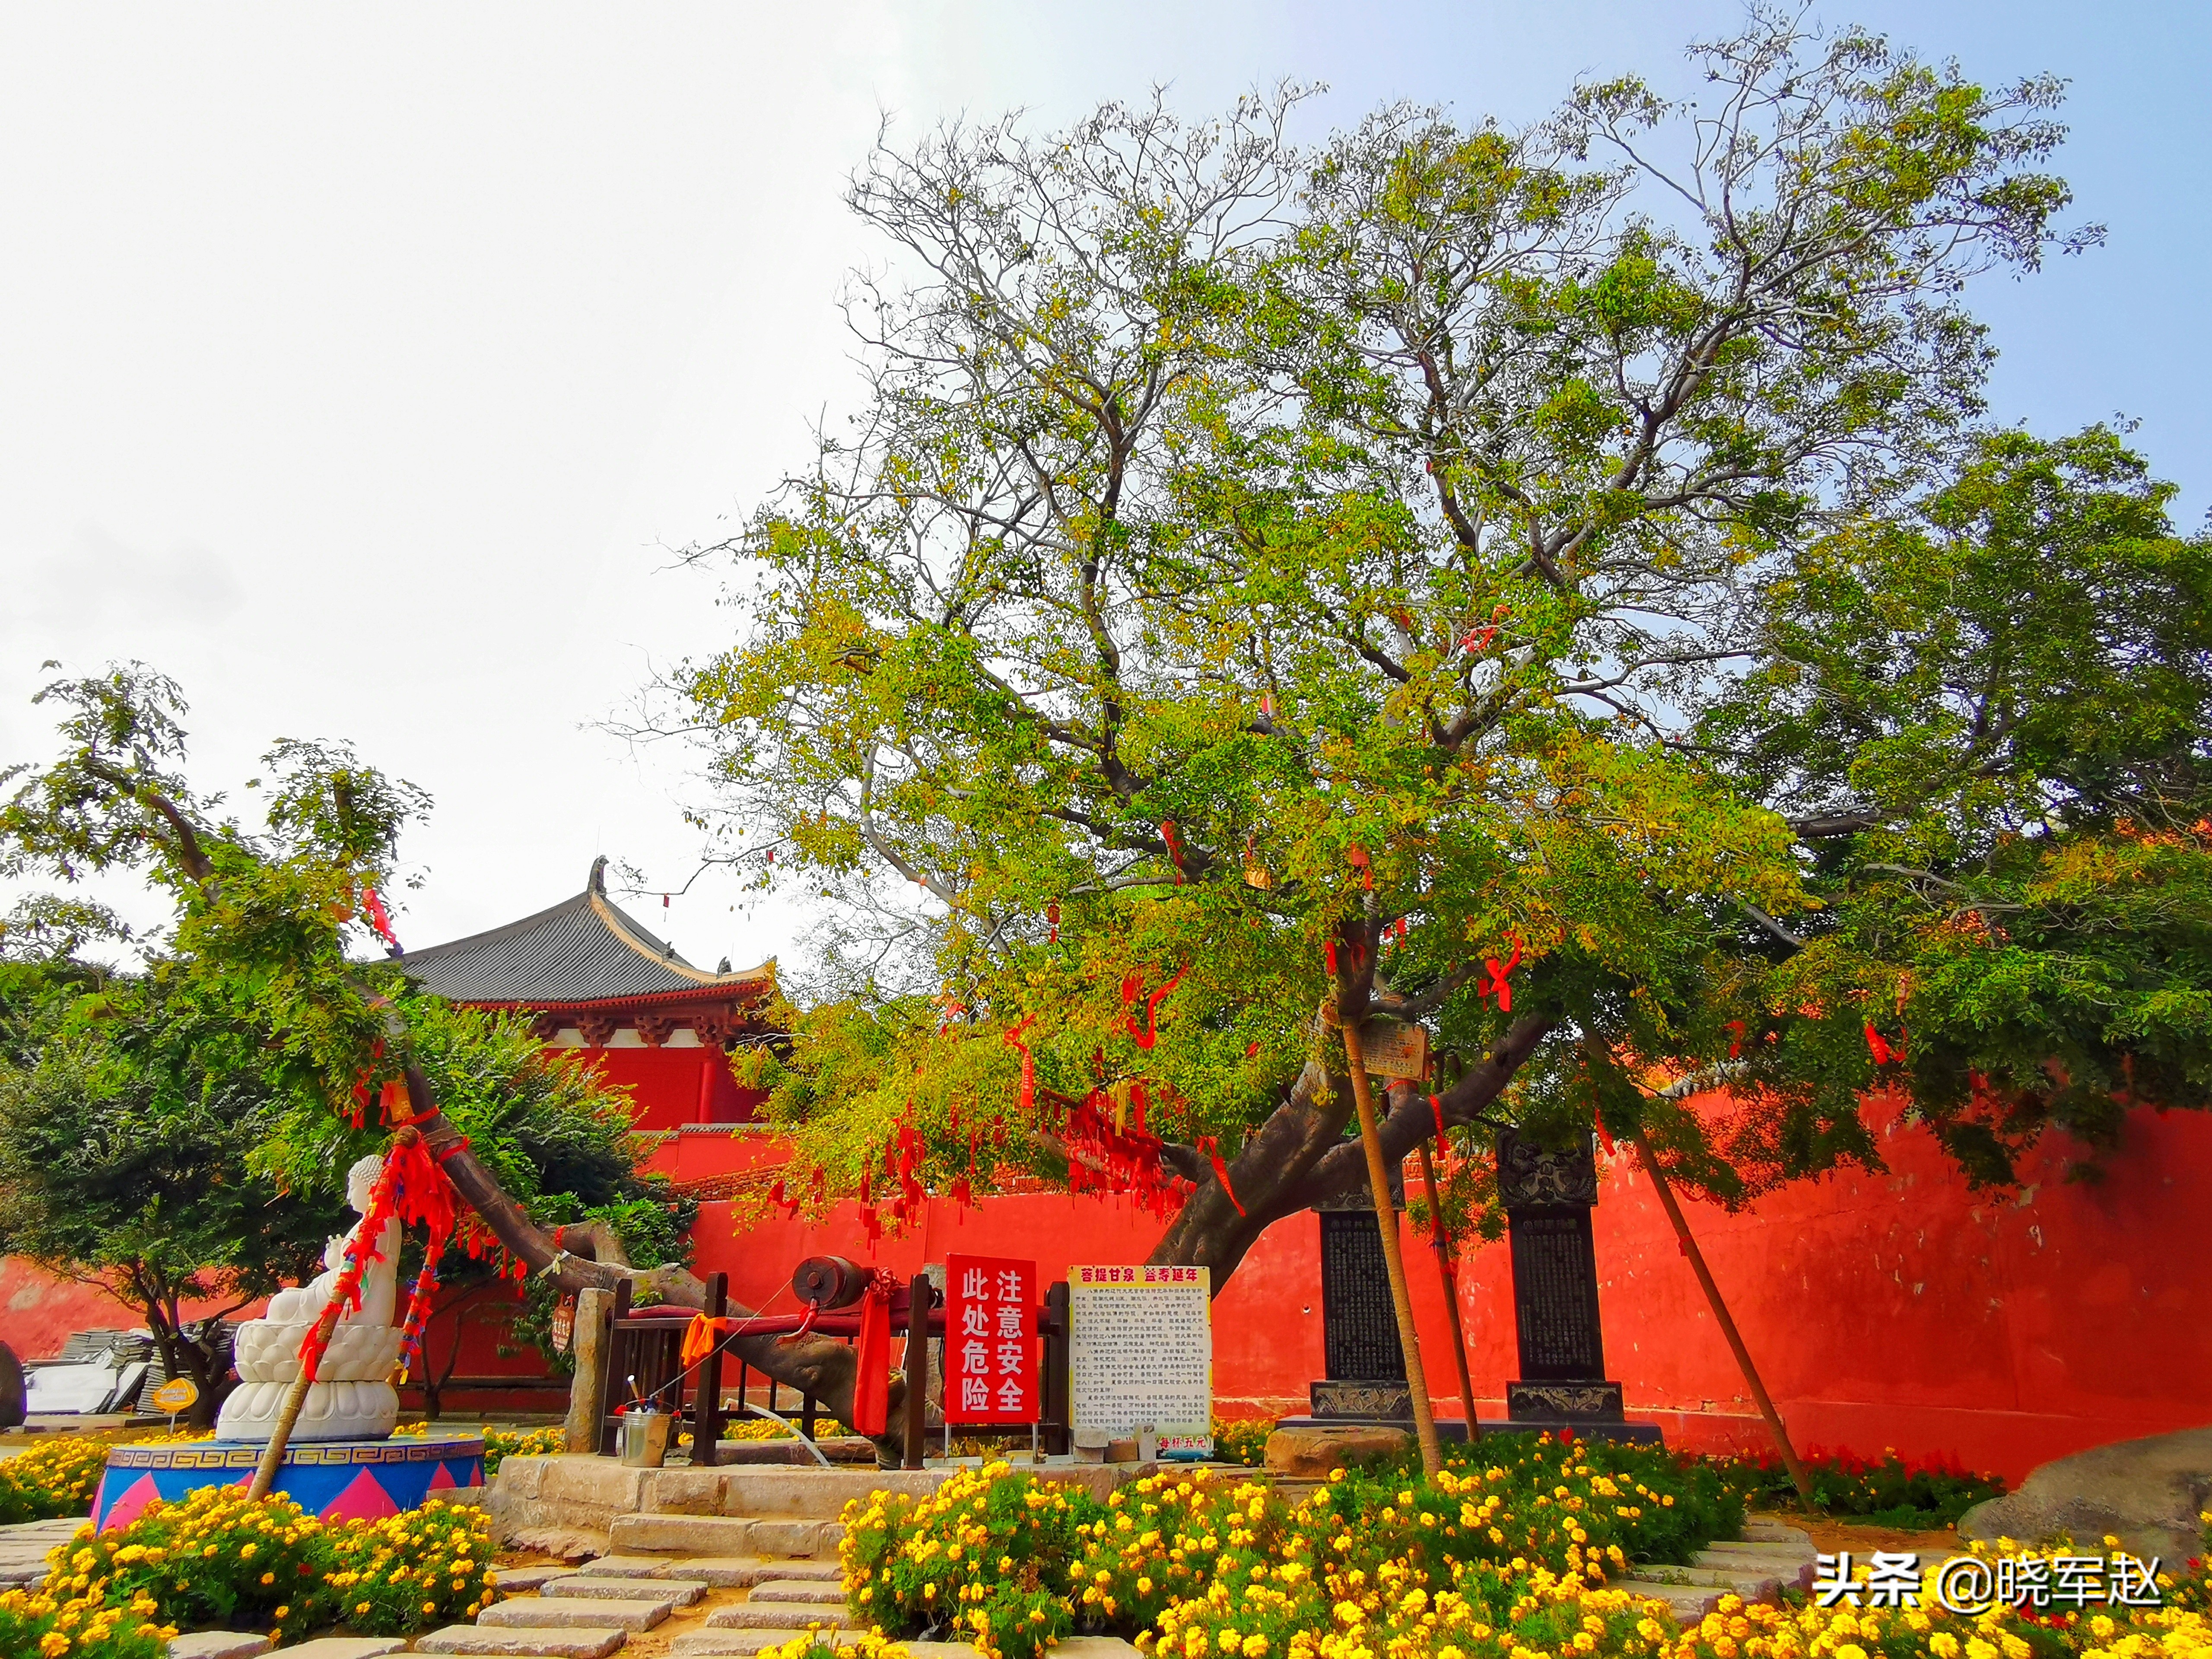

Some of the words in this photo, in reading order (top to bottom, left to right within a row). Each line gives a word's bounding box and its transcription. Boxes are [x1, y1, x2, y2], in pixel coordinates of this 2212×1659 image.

[960, 1268, 990, 1411] 此处危险
[996, 1270, 1024, 1411] 注意安全
[1081, 1268, 1135, 1282] 菩提甘泉
[1144, 1268, 1198, 1282] 益寿延年
